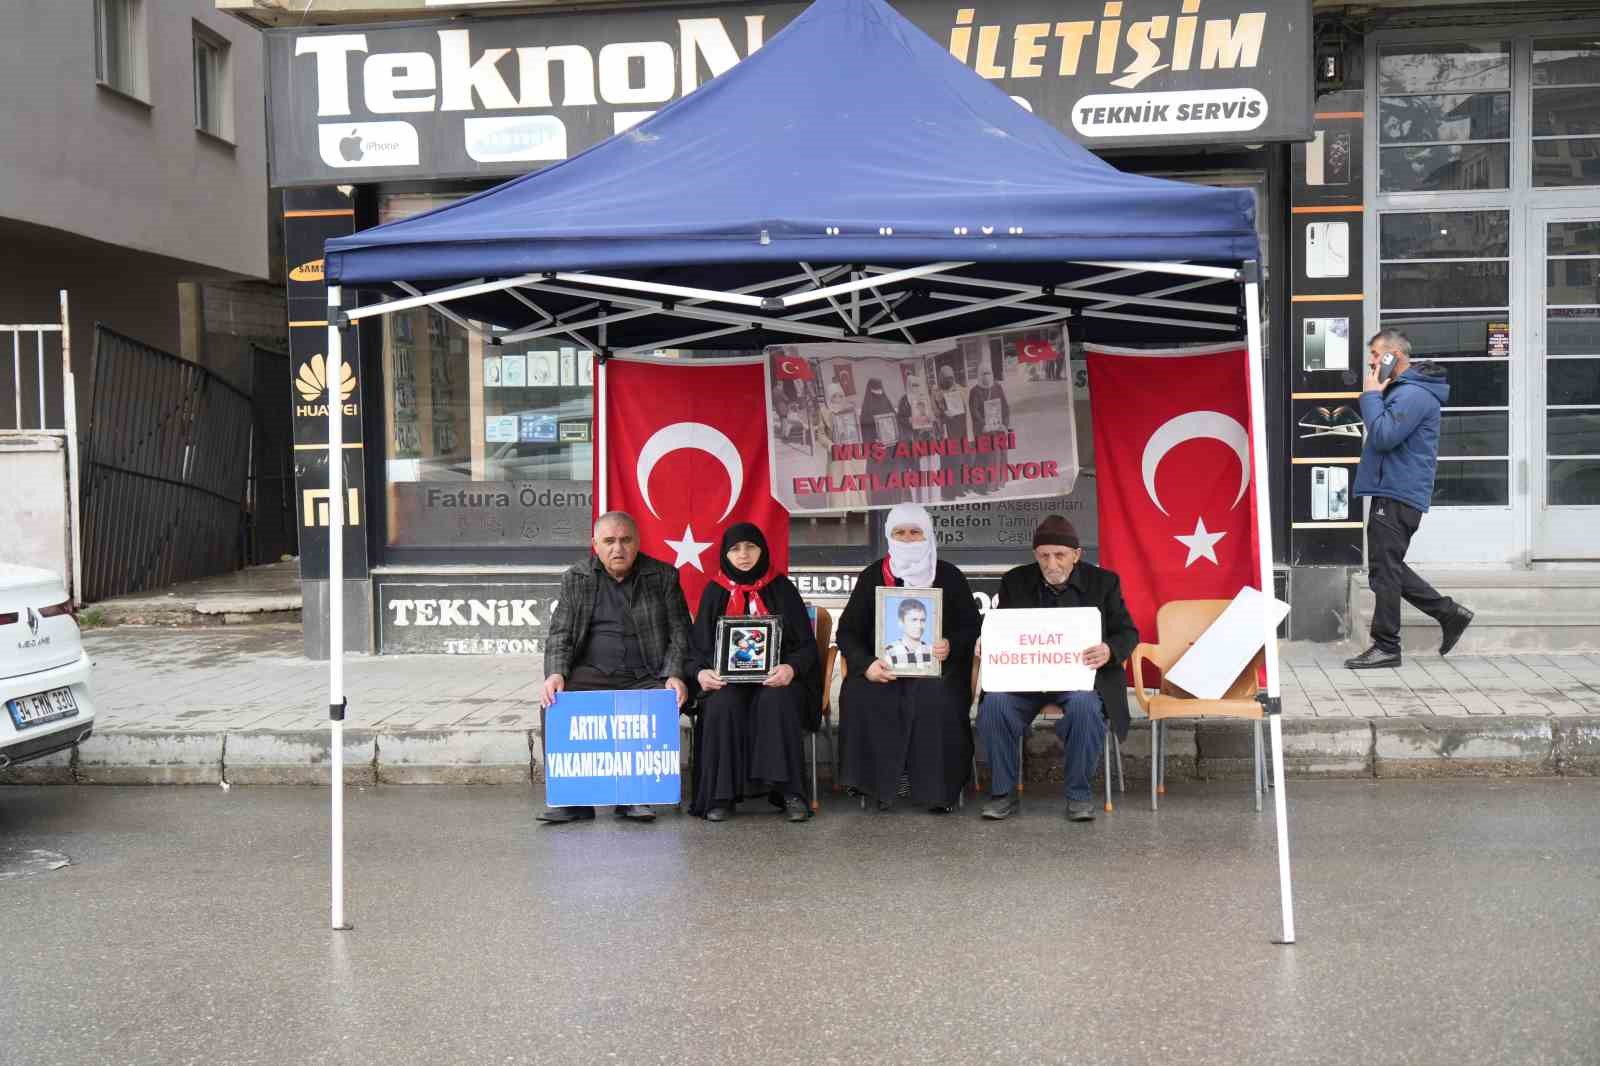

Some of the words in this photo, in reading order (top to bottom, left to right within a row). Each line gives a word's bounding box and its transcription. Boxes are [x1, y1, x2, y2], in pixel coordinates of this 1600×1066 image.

[949, 0, 1267, 89] İLETİŞİM
[1080, 100, 1169, 125] TEKNİK
[1176, 96, 1261, 121] SERVİS
[364, 141, 400, 153] iPhone
[297, 404, 358, 417] HUAEI
[832, 441, 887, 463] MUŞ
[793, 470, 954, 495] EVLATLARINI
[427, 489, 509, 507] Fatura
[932, 515, 991, 527] Telefon
[444, 638, 541, 656] TELEFON
[1019, 633, 1064, 646] EVLAT
[988, 650, 1081, 665] NÖBETİNDEY
[569, 714, 607, 740] ARTIK
[610, 714, 648, 740] YETER
[547, 750, 632, 777] YAKAMIZDAN
[636, 744, 680, 783] DÜŞÜN
